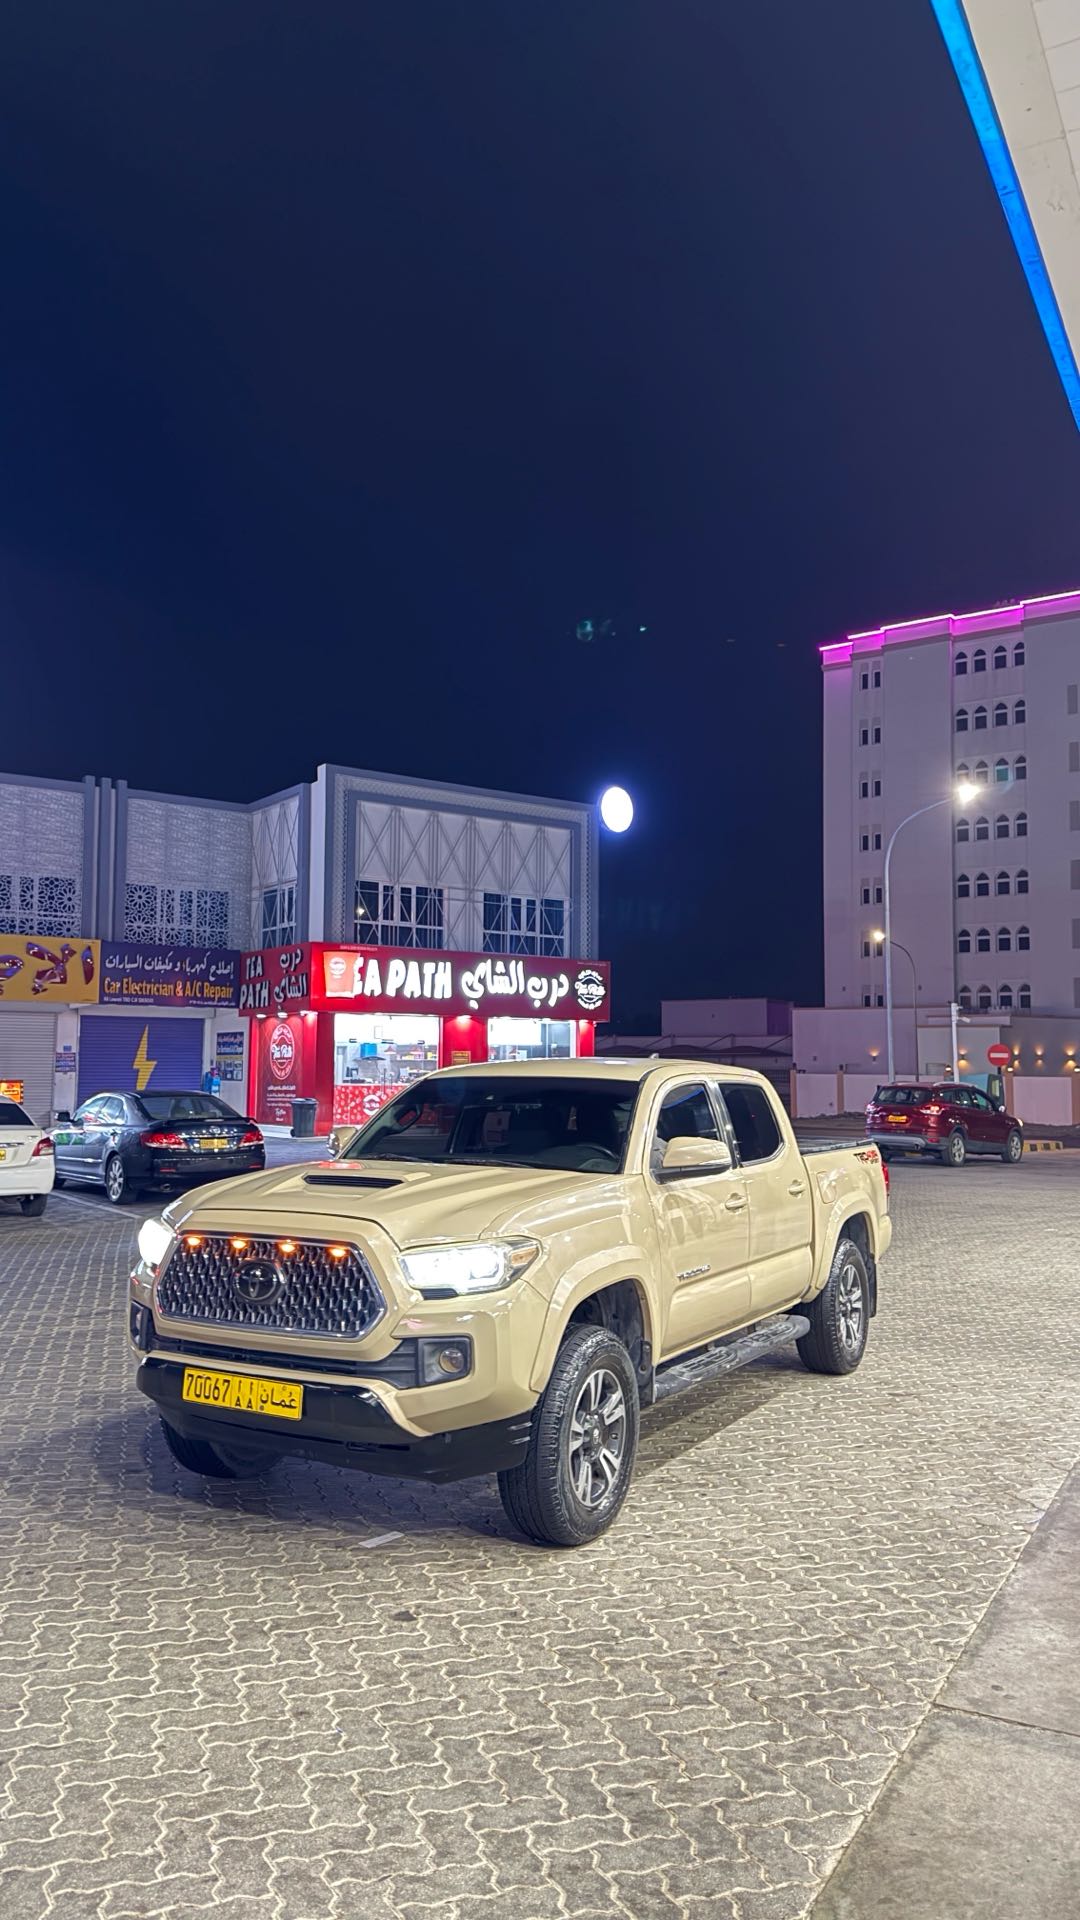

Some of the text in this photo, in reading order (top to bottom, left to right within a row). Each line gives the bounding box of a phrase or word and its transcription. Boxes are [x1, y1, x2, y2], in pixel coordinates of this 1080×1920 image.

[105, 953, 142, 973] السيارات
[208, 961, 234, 981] إصلاح
[246, 955, 263, 980] TEA
[280, 948, 302, 974] درب
[104, 977, 233, 1001] Car Electrician & A/C Repair
[385, 959, 453, 999] PATH
[461, 958, 569, 1010] درب الشاي
[240, 980, 269, 1010] PATH
[186, 1373, 230, 1403] 70067
[234, 1396, 253, 1410] A A
